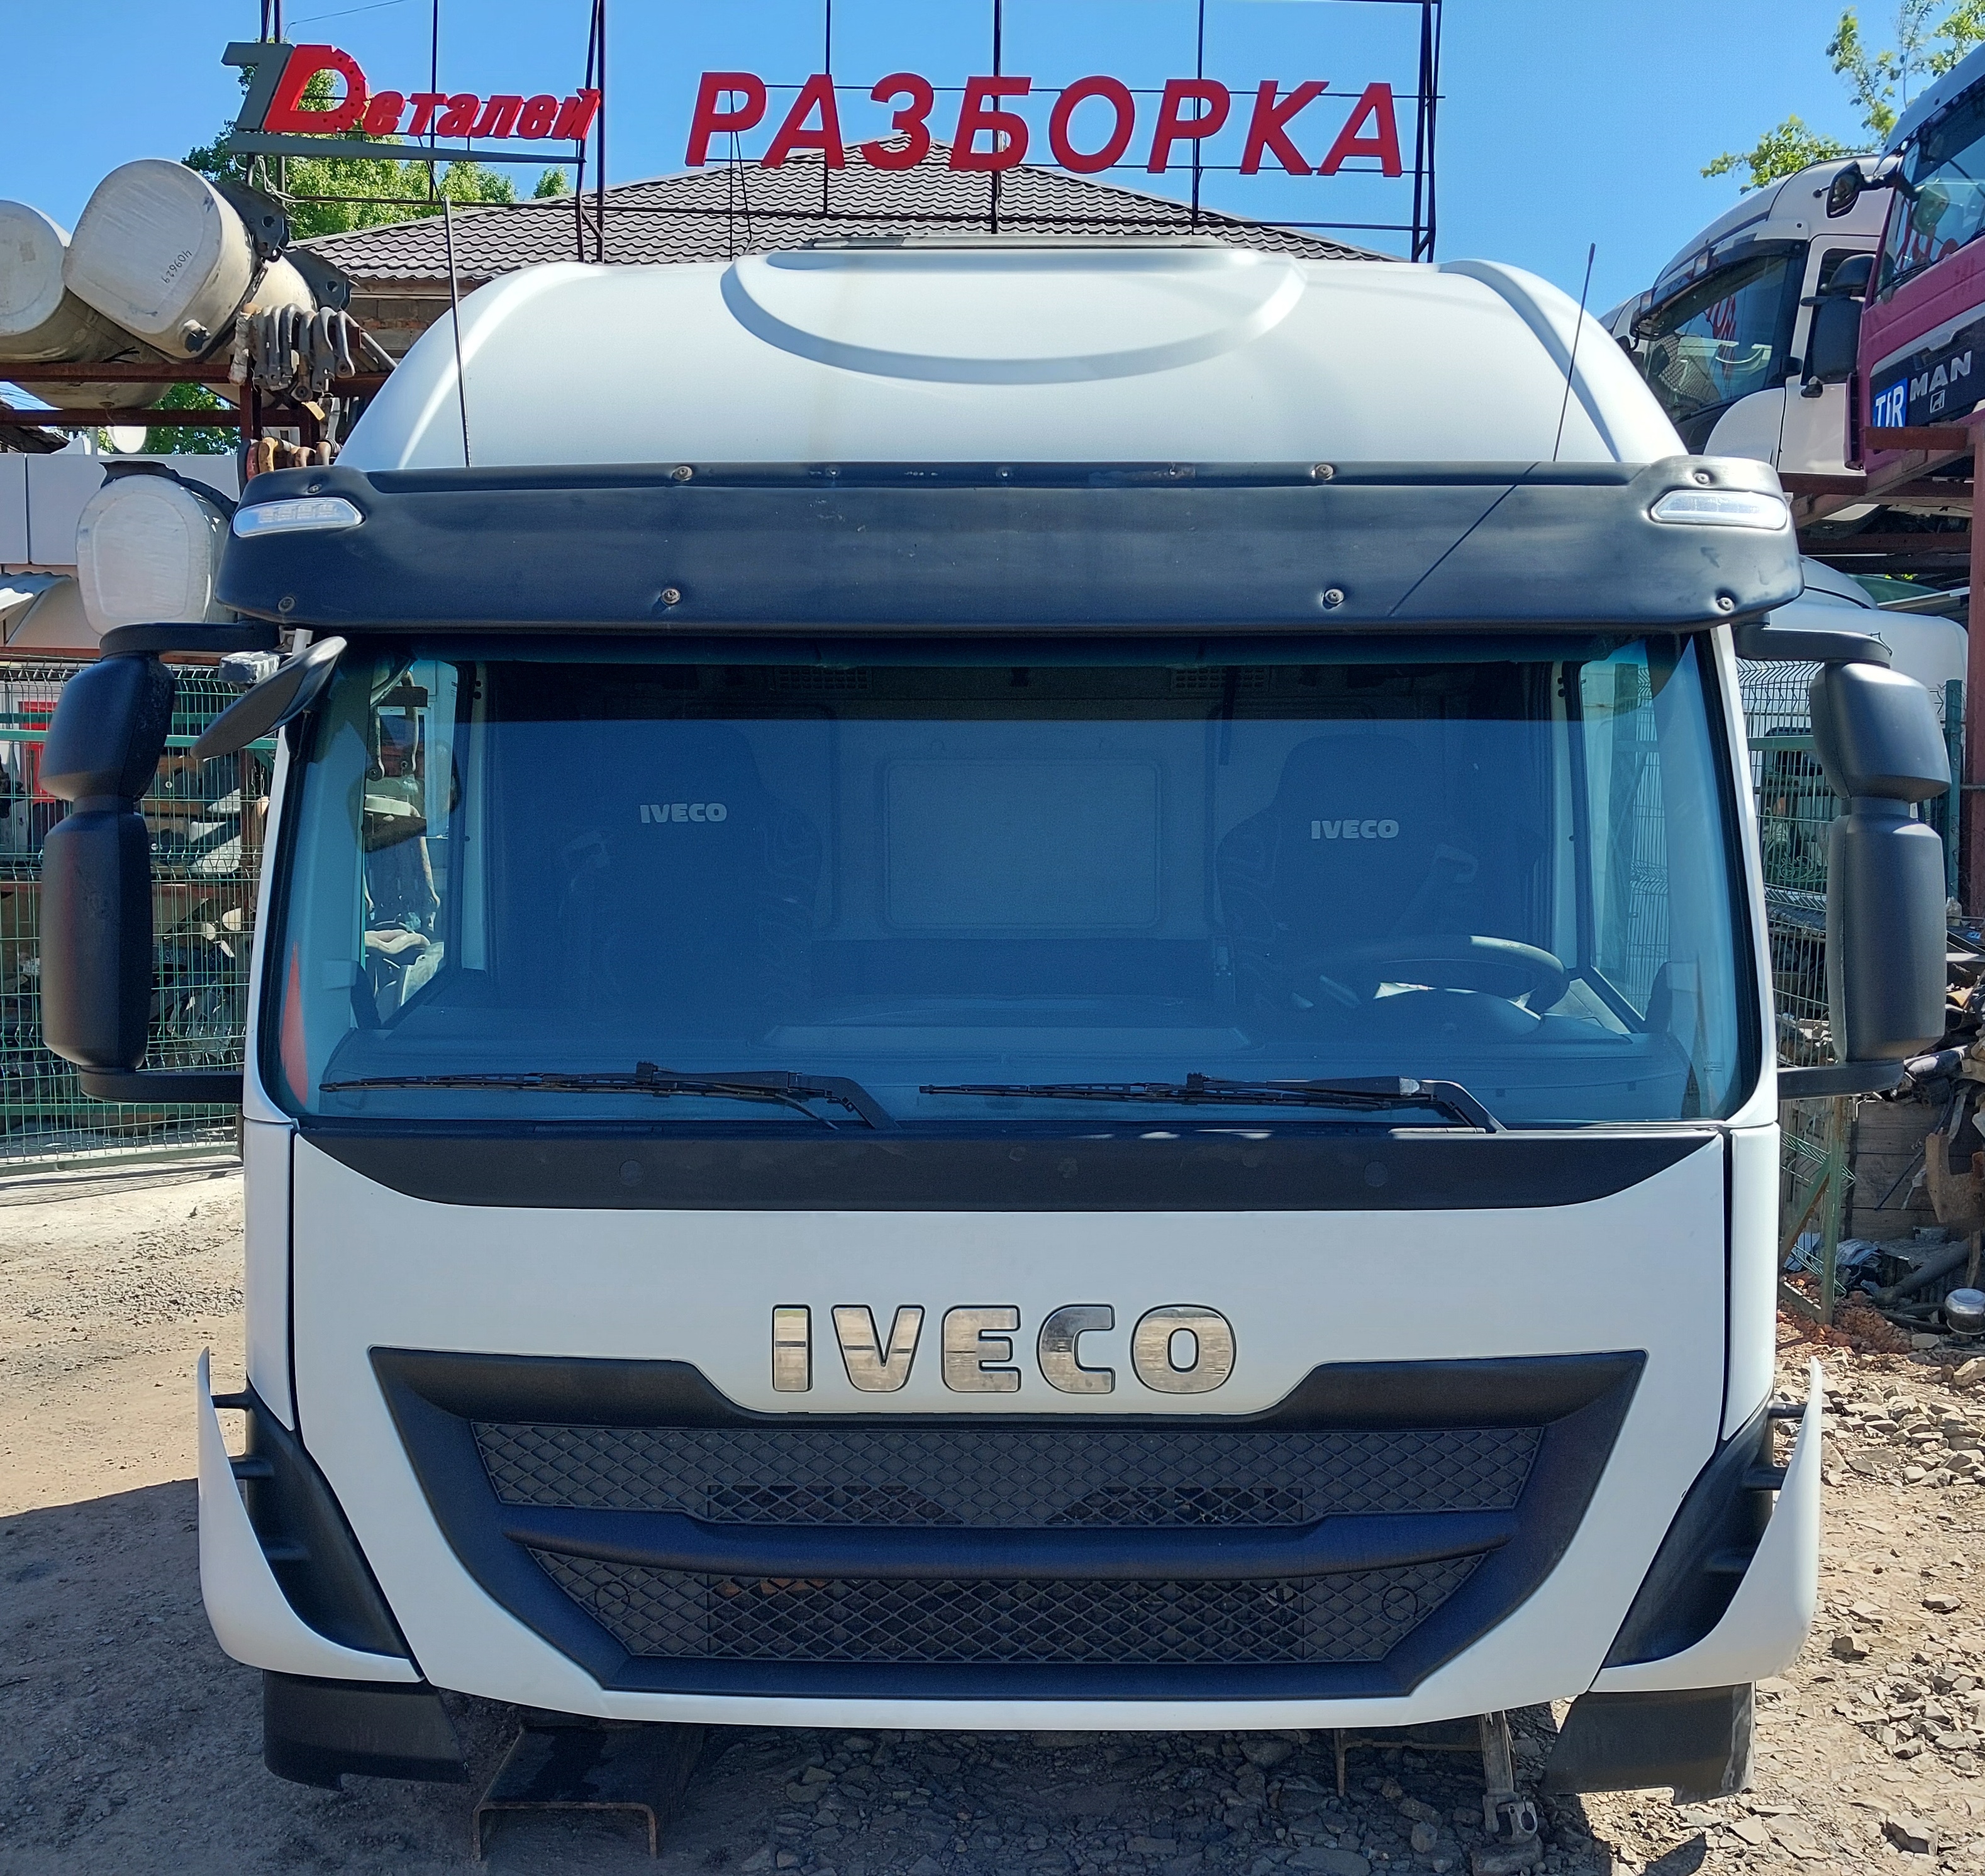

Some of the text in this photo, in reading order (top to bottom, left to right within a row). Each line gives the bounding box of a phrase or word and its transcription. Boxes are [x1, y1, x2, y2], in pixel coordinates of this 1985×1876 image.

[685, 72, 1403, 177] РАЗБОРКА
[1909, 350, 1972, 402] MAN
[1875, 385, 1904, 428] TIR
[640, 802, 728, 823] IVECO
[1311, 819, 1399, 840] IVECO
[772, 1303, 1237, 1394] IVECO
